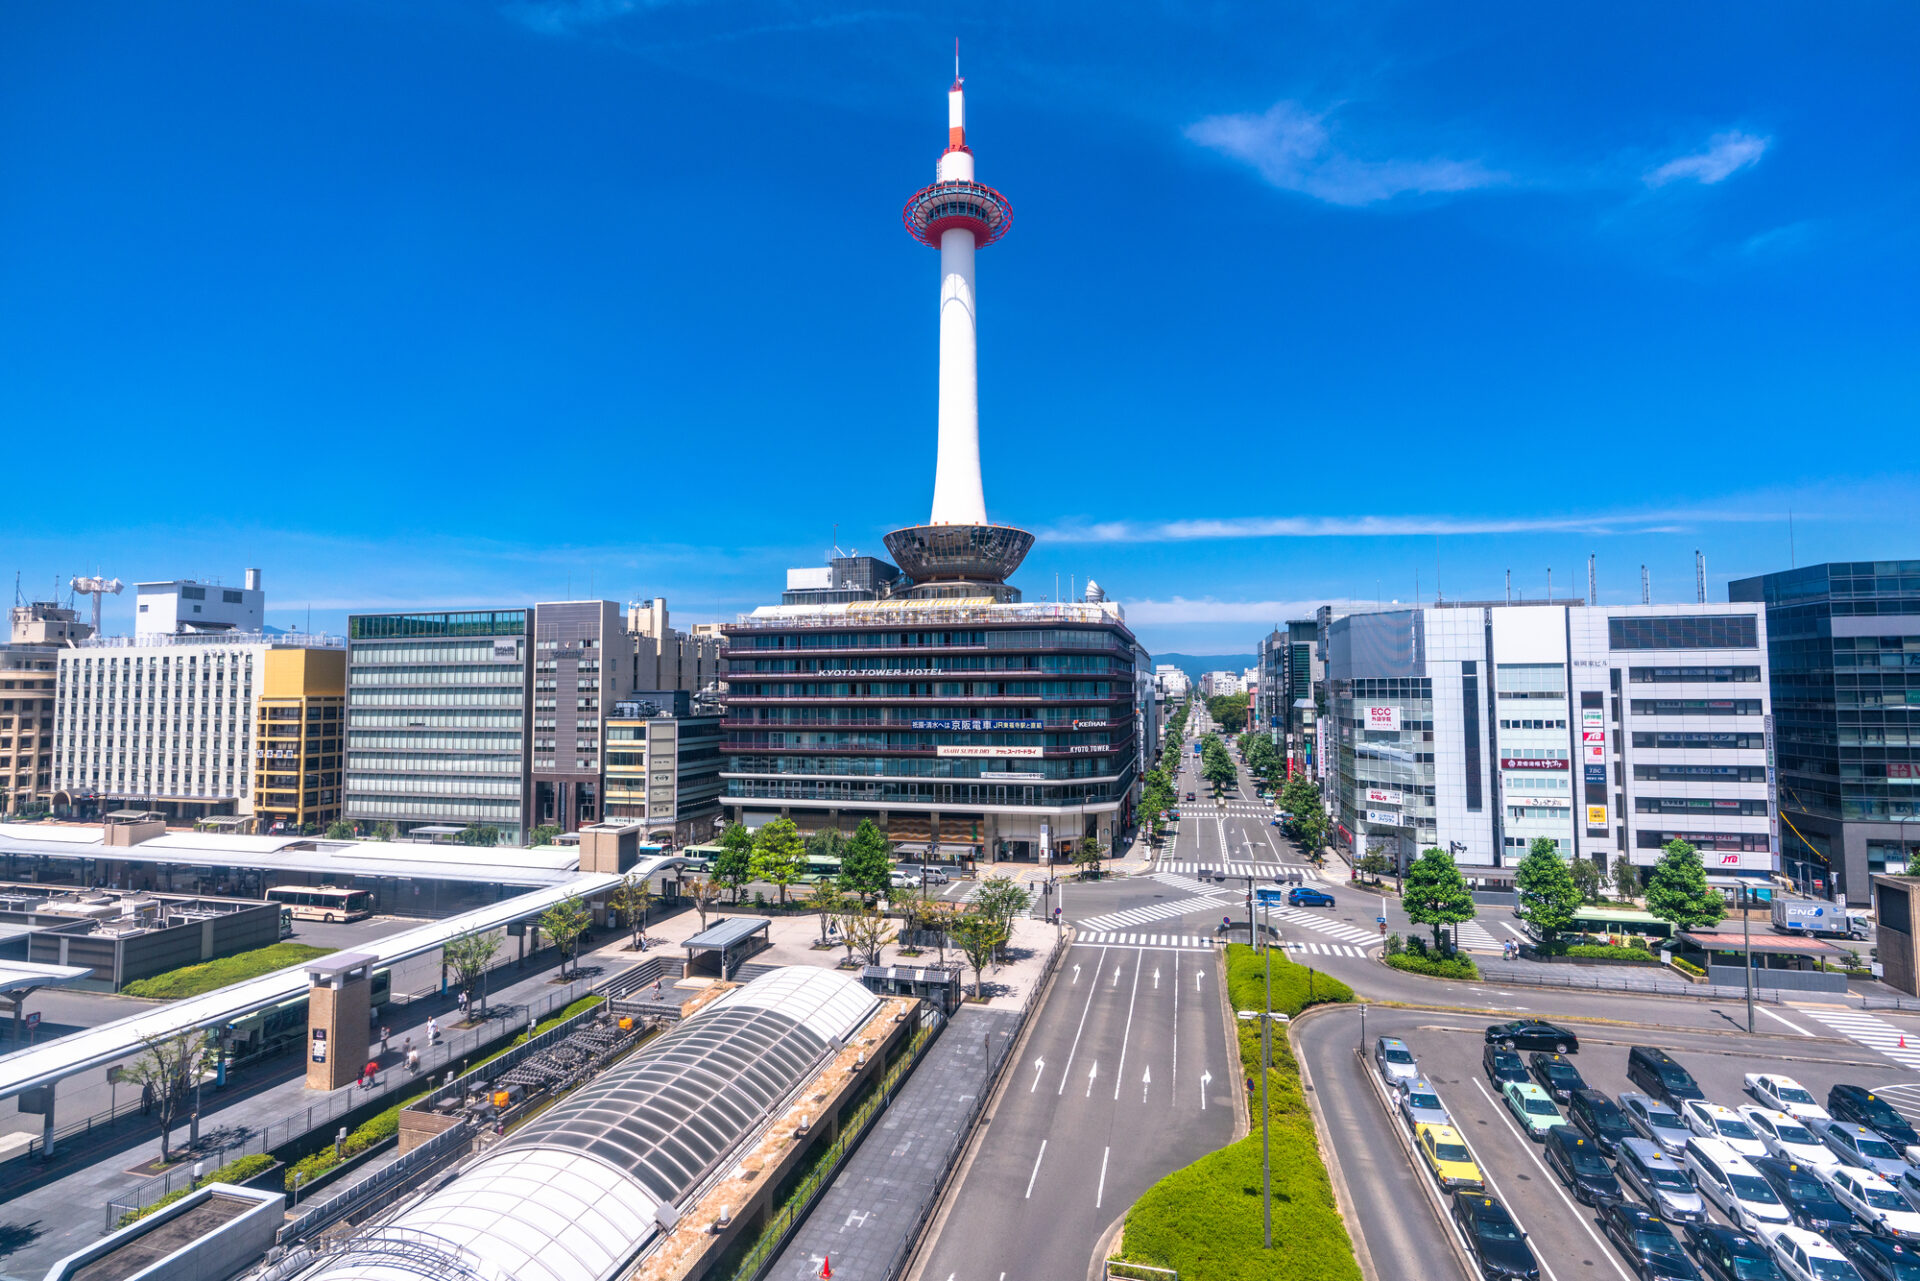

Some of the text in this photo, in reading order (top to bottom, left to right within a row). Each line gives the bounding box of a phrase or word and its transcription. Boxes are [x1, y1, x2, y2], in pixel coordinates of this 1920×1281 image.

[818, 668, 945, 677] KYOTO TOWER HOTEL
[1371, 707, 1392, 716] ECC
[951, 720, 992, 731] 京阪電車
[1721, 855, 1738, 864] JTB
